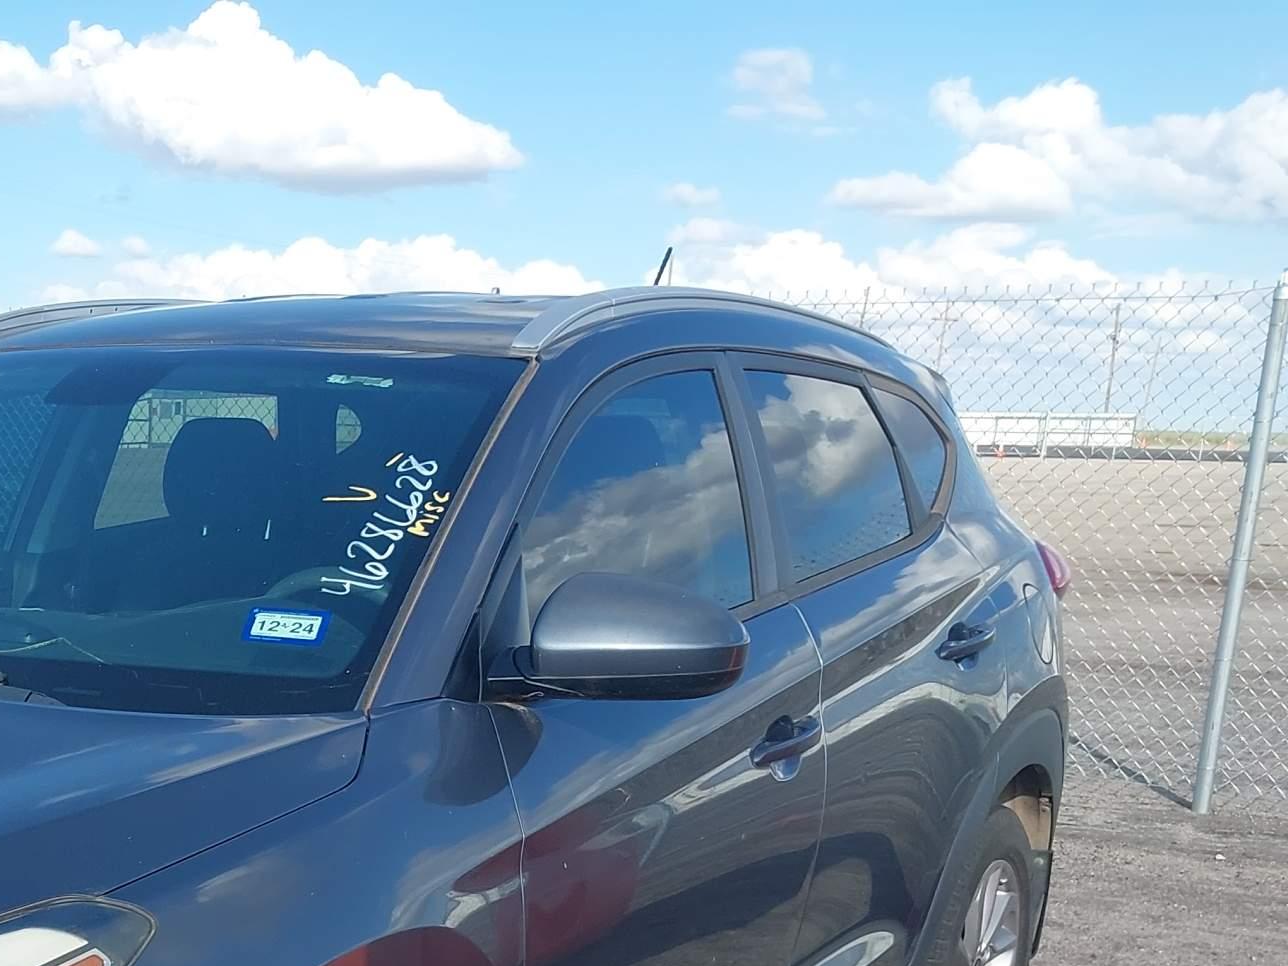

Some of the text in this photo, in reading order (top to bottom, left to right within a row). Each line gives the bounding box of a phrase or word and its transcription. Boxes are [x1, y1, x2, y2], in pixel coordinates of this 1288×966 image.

[321, 454, 438, 595] 46286628
[258, 620, 314, 634] 12 24
